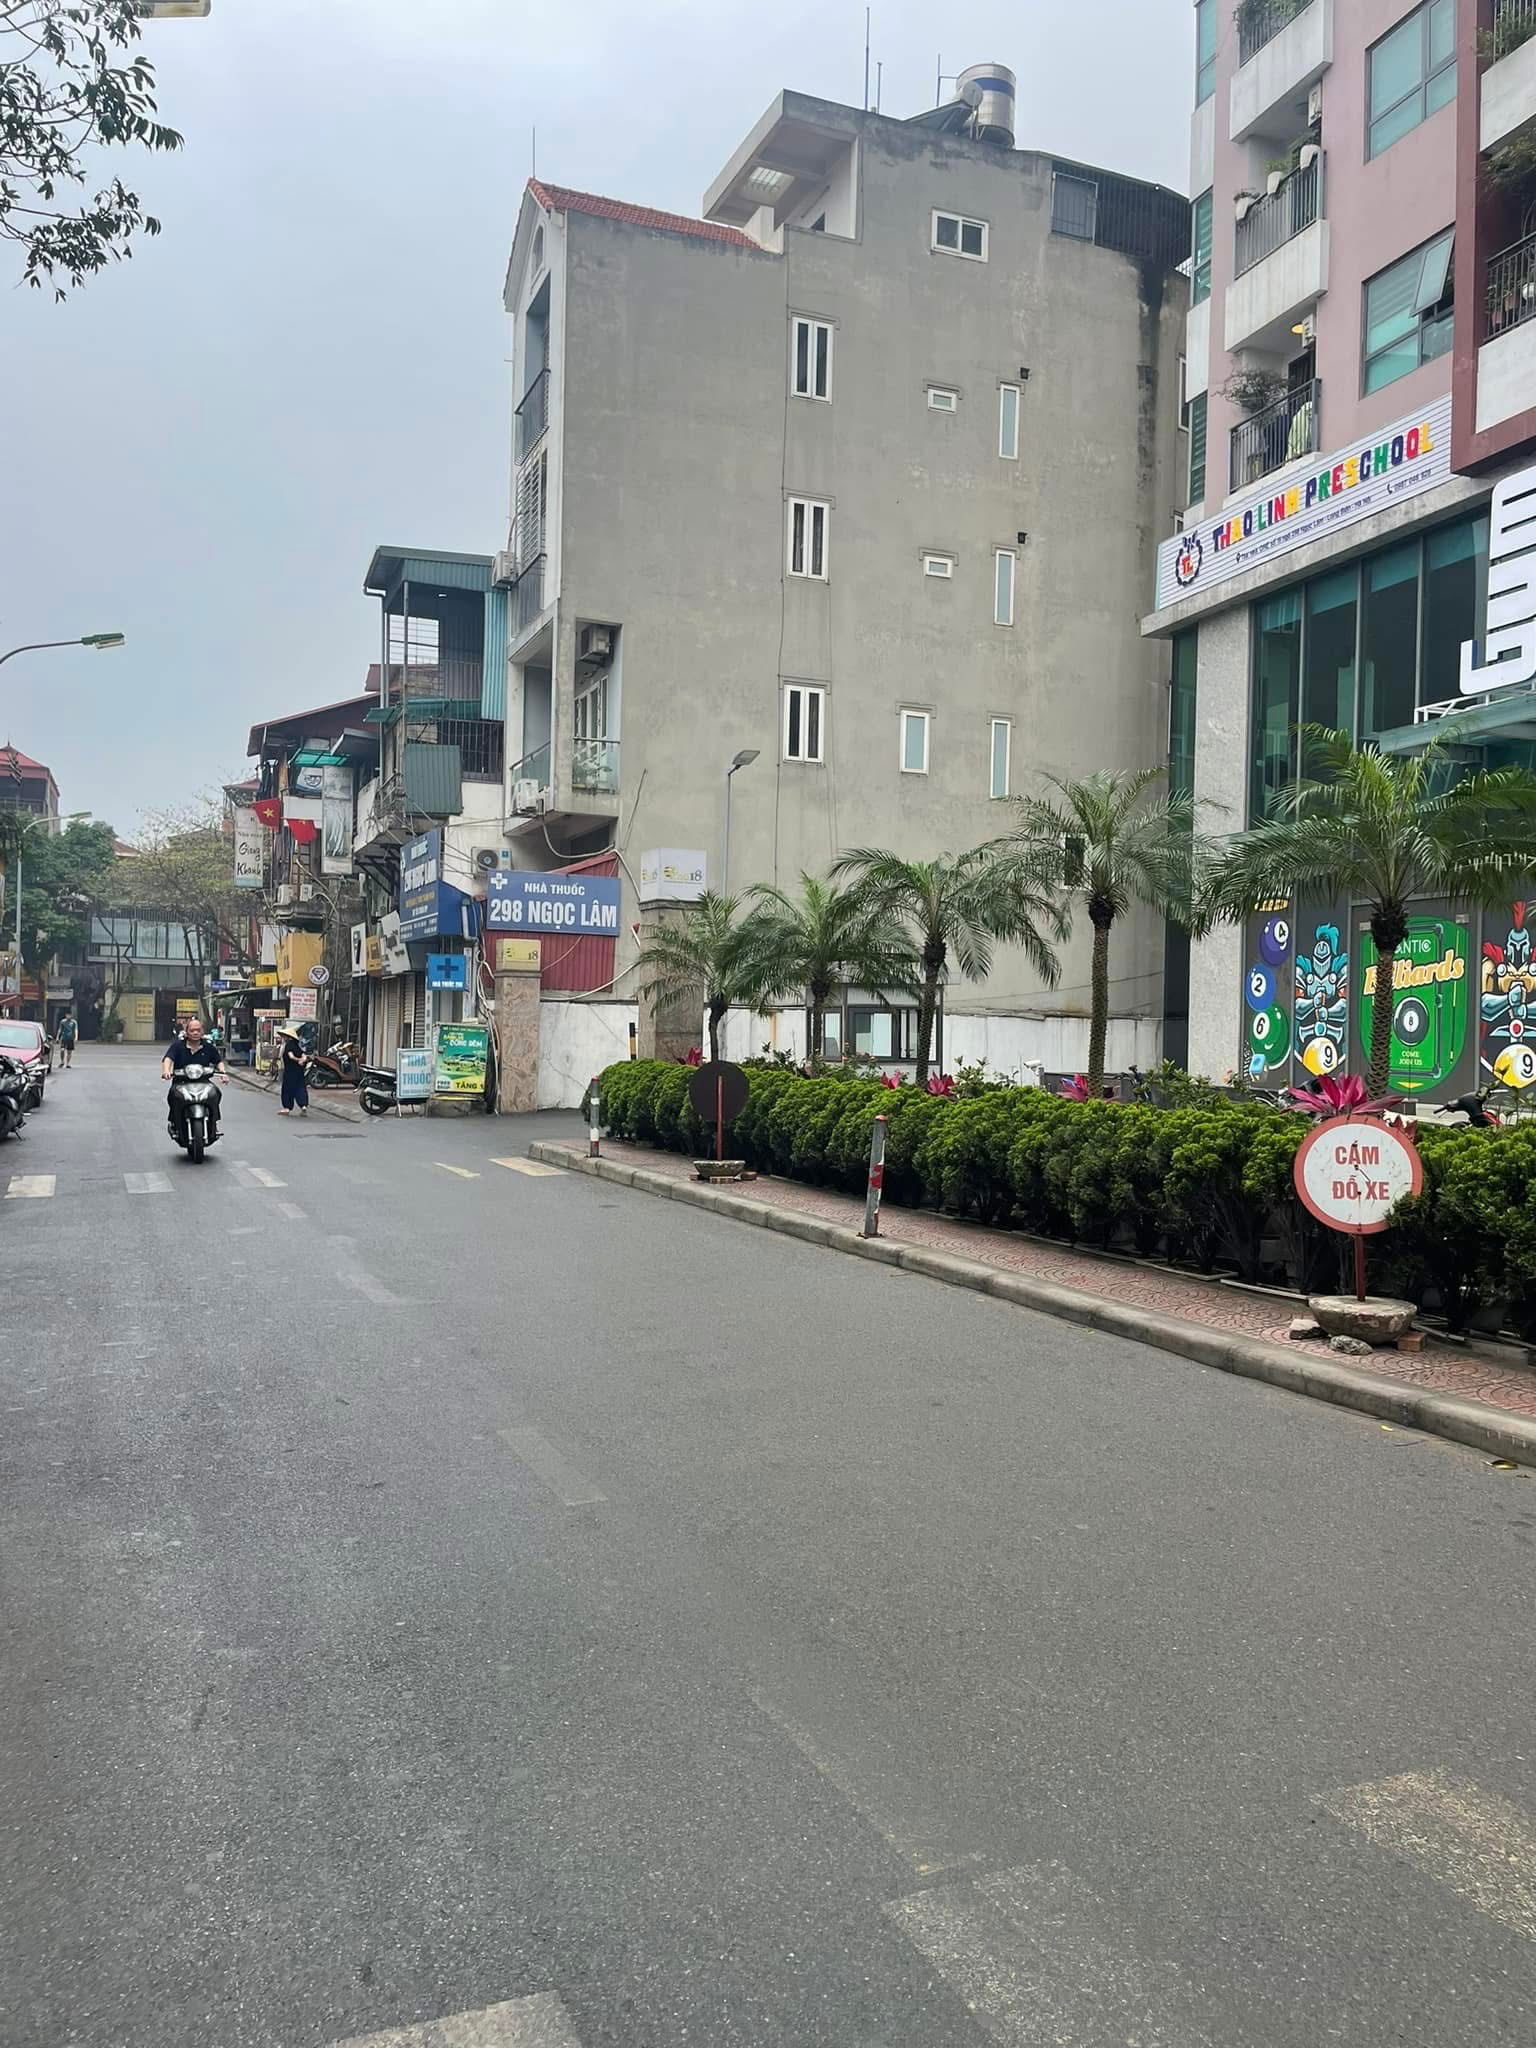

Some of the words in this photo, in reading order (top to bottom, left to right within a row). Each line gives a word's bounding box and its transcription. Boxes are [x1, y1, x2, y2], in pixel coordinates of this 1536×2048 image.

[1258, 486, 1300, 530] LINH
[1305, 423, 1434, 508] PRESCHOOL
[524, 882, 548, 894] NHÀ
[550, 882, 585, 896] THUỐC
[490, 898, 522, 922] 298
[528, 901, 576, 930] NGỌC
[581, 900, 617, 928] LÂM
[1279, 923, 1286, 938] 4
[1254, 977, 1262, 993] 2
[1256, 1017, 1265, 1034] 6
[1408, 1016, 1414, 1026] 8
[1324, 1046, 1333, 1064] 9
[1522, 1053, 1533, 1074] 9
[1365, 1181, 1390, 1200] XE
